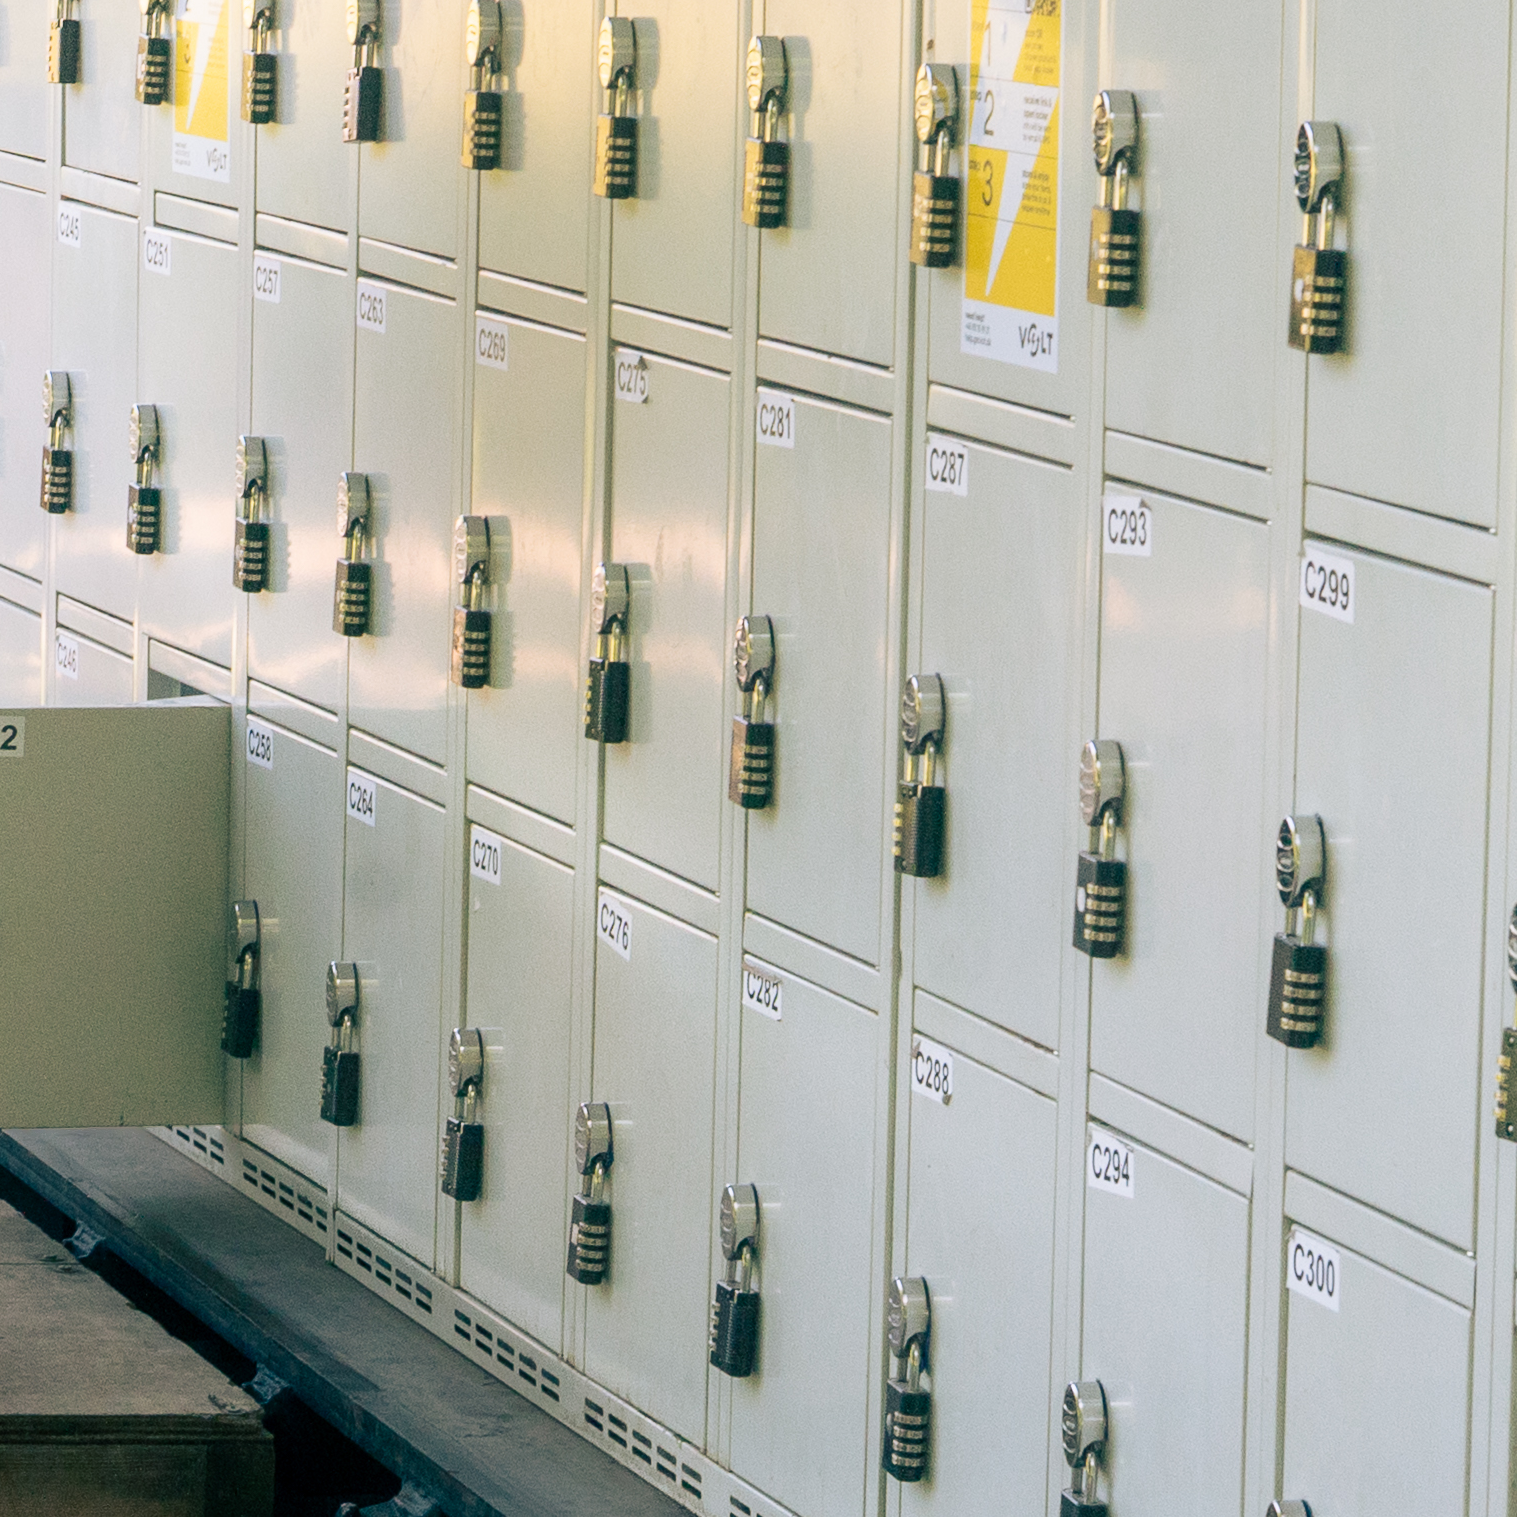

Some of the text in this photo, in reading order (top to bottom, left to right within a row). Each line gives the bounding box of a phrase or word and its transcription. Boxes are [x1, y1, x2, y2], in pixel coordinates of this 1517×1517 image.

[984, 89, 995, 136] 2
[982, 159, 994, 206] 3
[60, 212, 79, 241] C245
[147, 239, 169, 268] C251
[256, 265, 279, 297] C257
[359, 292, 383, 325] C263
[479, 328, 506, 363] C269
[1018, 323, 1054, 357] VOLT
[618, 361, 646, 395] C275
[759, 404, 791, 439] C281
[929, 447, 965, 486] C287
[1108, 508, 1148, 546] C293
[1305, 561, 1350, 611] C299
[57, 643, 77, 673] C246
[248, 729, 271, 761] C258
[349, 782, 374, 818] C264
[473, 839, 499, 875] C270
[600, 903, 630, 951] C276
[746, 973, 780, 1012] C282
[913, 1050, 950, 1095] C288
[1092, 1143, 1131, 1187] C294
[1294, 1243, 1336, 1297] C300
